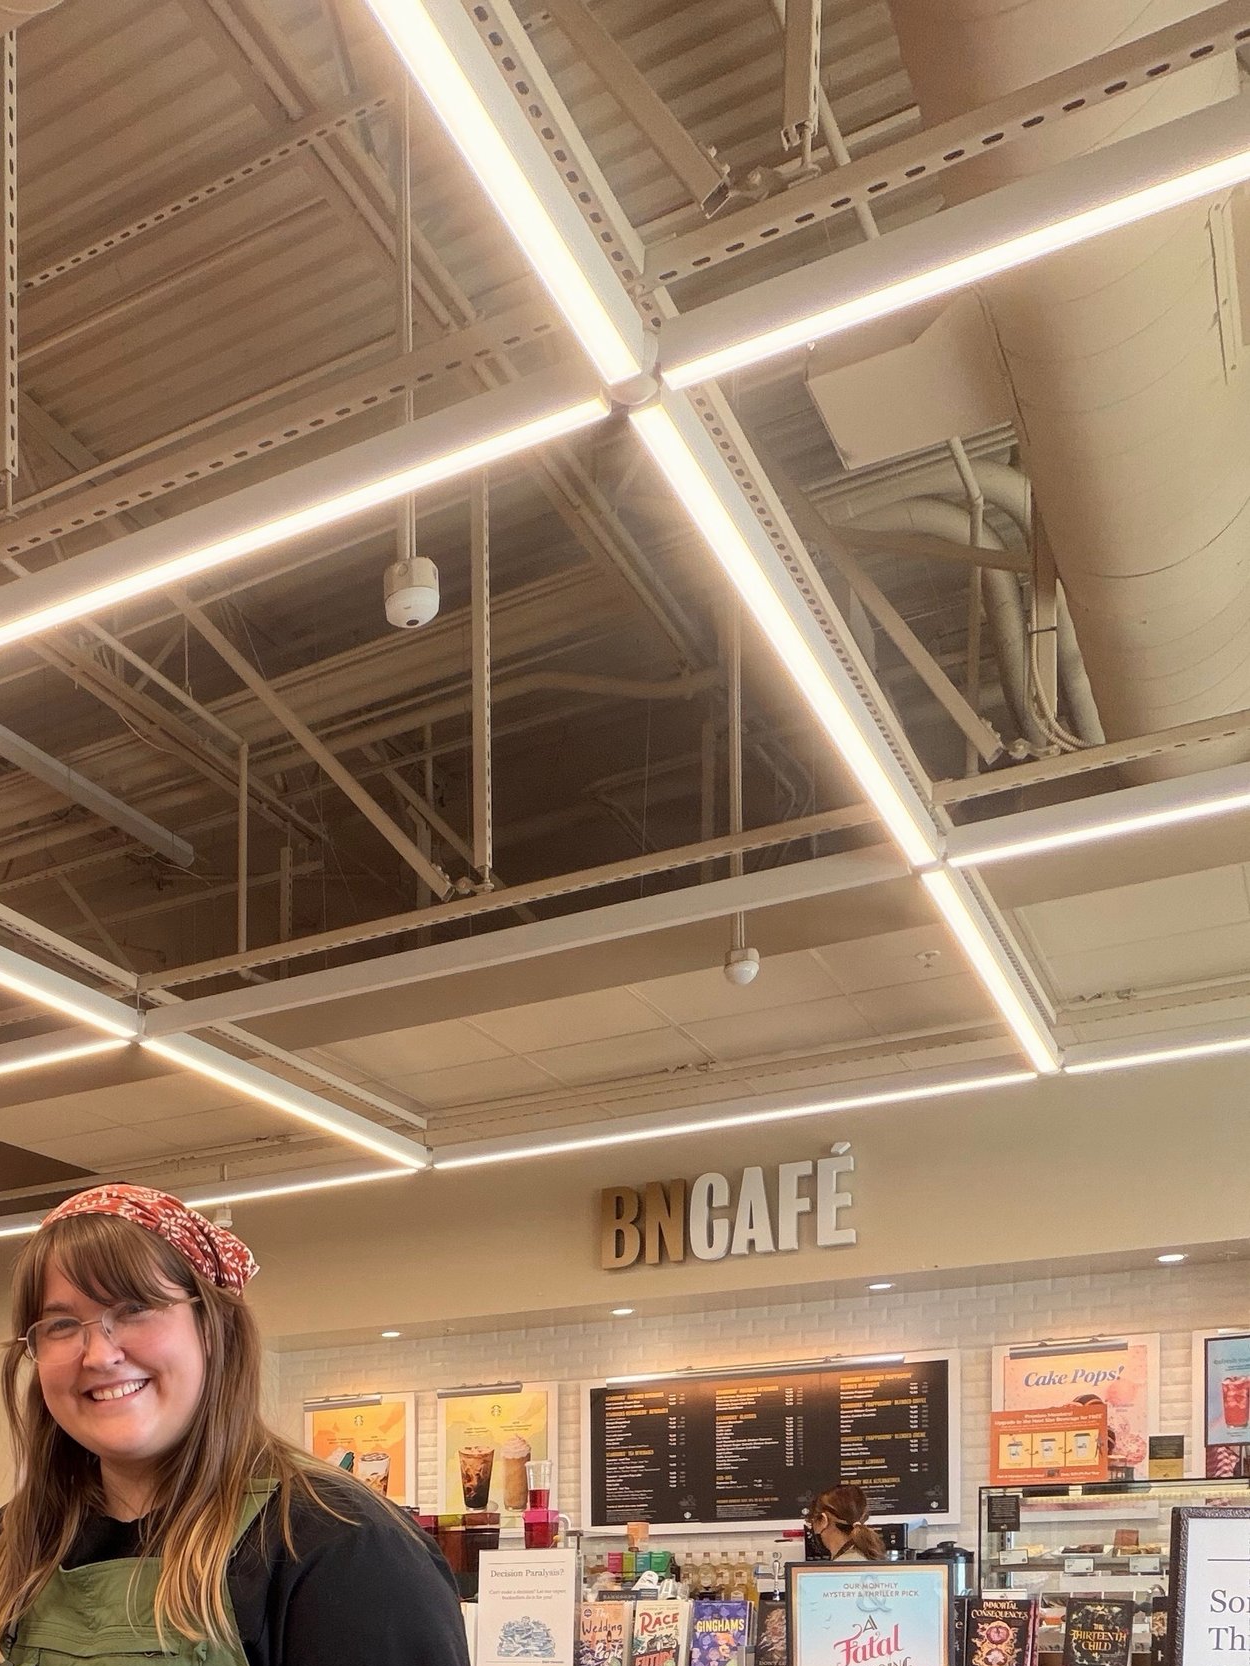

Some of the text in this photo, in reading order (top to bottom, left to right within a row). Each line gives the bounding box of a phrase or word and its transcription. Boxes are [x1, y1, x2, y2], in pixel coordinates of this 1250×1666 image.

[1023, 1365, 1125, 1388] Cake Pops!
[490, 1568, 565, 1579] Decision Paralysis?
[843, 1582, 899, 1590] OUR MONTHLY
[822, 1590, 856, 1598] MYSTERY
[901, 1589, 919, 1597] PICK
[982, 1600, 1019, 1611] IMMORTAL
[970, 1609, 1029, 1620] CONSEQUENCES
[581, 1620, 623, 1636] Wedding
[639, 1611, 680, 1637] RACE
[696, 1618, 745, 1633] GINGHAMS
[862, 1614, 878, 1633] A
[1069, 1629, 1128, 1644] THIRTEENTH
[1081, 1641, 1112, 1652] CHILD
